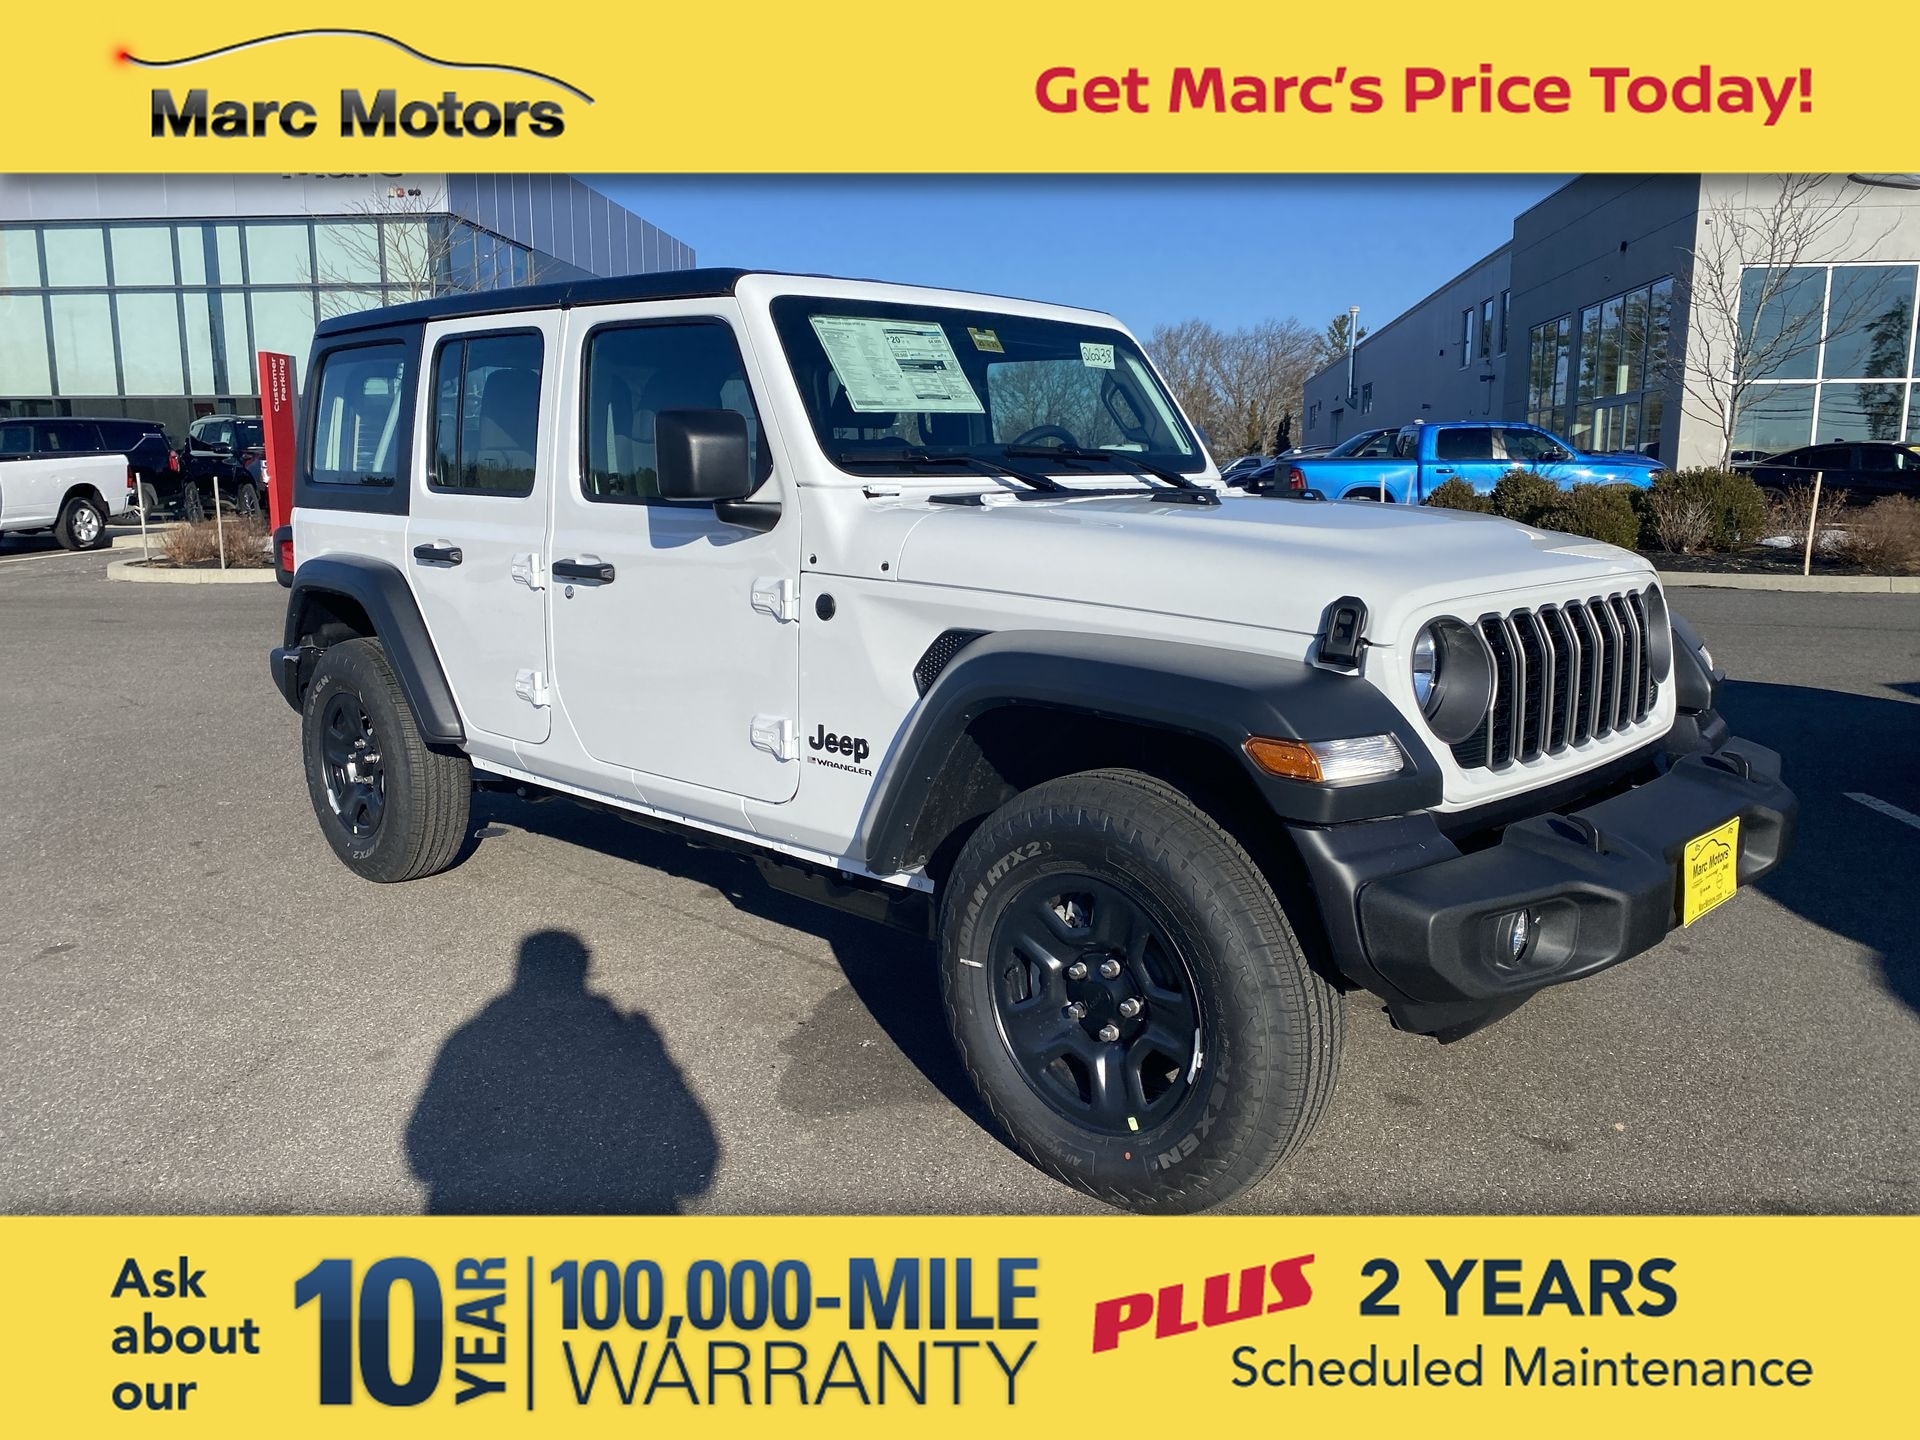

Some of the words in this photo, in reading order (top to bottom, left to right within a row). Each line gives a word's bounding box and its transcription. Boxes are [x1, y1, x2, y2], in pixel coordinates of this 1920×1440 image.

[271, 357, 280, 412] Customer
[279, 358, 287, 402] Parking
[808, 724, 870, 764] Jeep
[816, 758, 873, 777] WRANGLER
[986, 841, 1042, 887] HTX2
[1693, 863, 1708, 879] Marc
[1709, 850, 1729, 868] Motors
